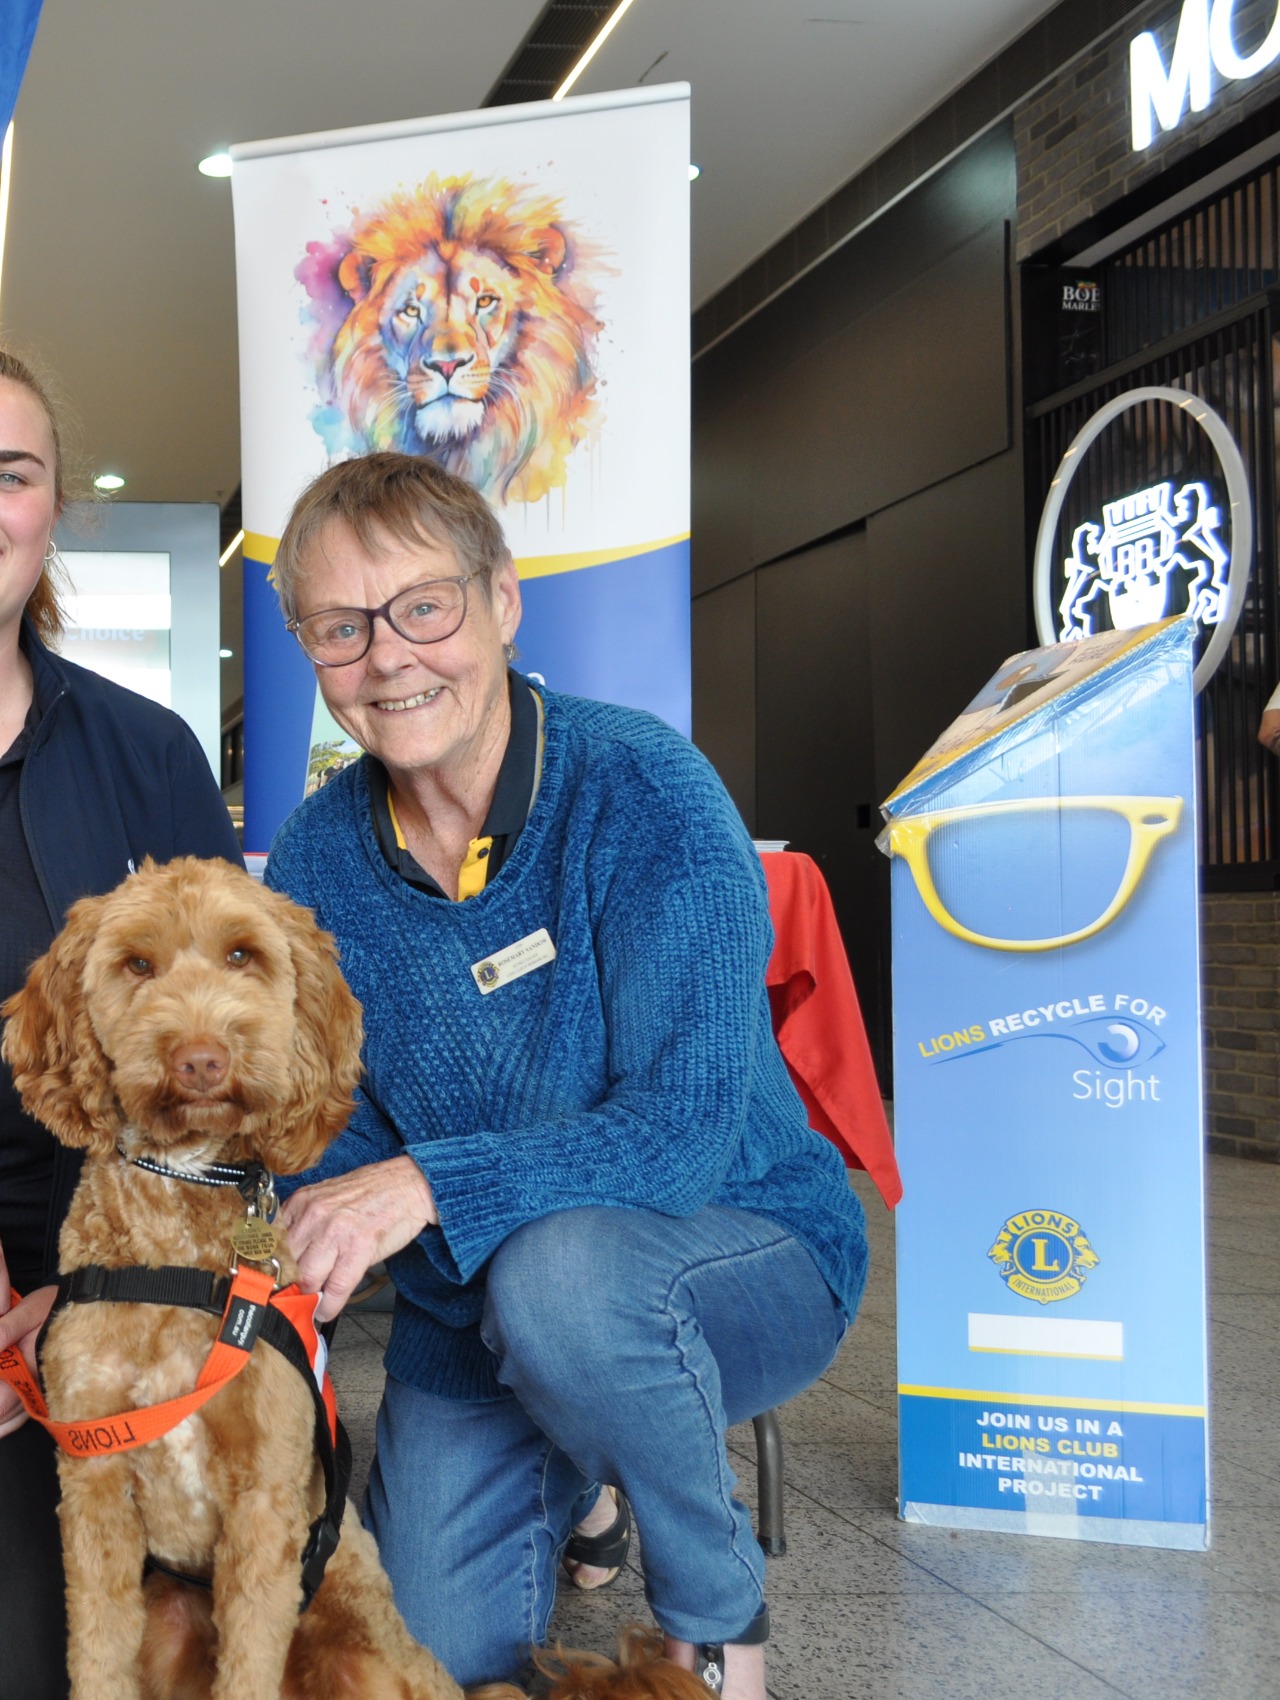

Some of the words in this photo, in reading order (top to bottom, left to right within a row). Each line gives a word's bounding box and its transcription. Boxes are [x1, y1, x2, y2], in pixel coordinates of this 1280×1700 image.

[918, 1025, 986, 1058] LIONS
[988, 994, 1107, 1037] RECYCLE
[1114, 994, 1167, 1027] FOR
[1072, 1069, 1161, 1109] Sight
[1011, 1213, 1075, 1234] LIONS
[1031, 1238, 1060, 1271] L
[1012, 1278, 1075, 1297] INTERNATIONAL
[976, 1411, 1031, 1430] JOIN
[1038, 1415, 1069, 1433] US
[1075, 1418, 1101, 1435] IN
[1106, 1421, 1123, 1436] A
[981, 1432, 1050, 1453] LIONS
[1057, 1439, 1119, 1458] CLUB
[958, 1452, 1144, 1482] INTERNATIONAL
[998, 1477, 1103, 1501] PROJECT
